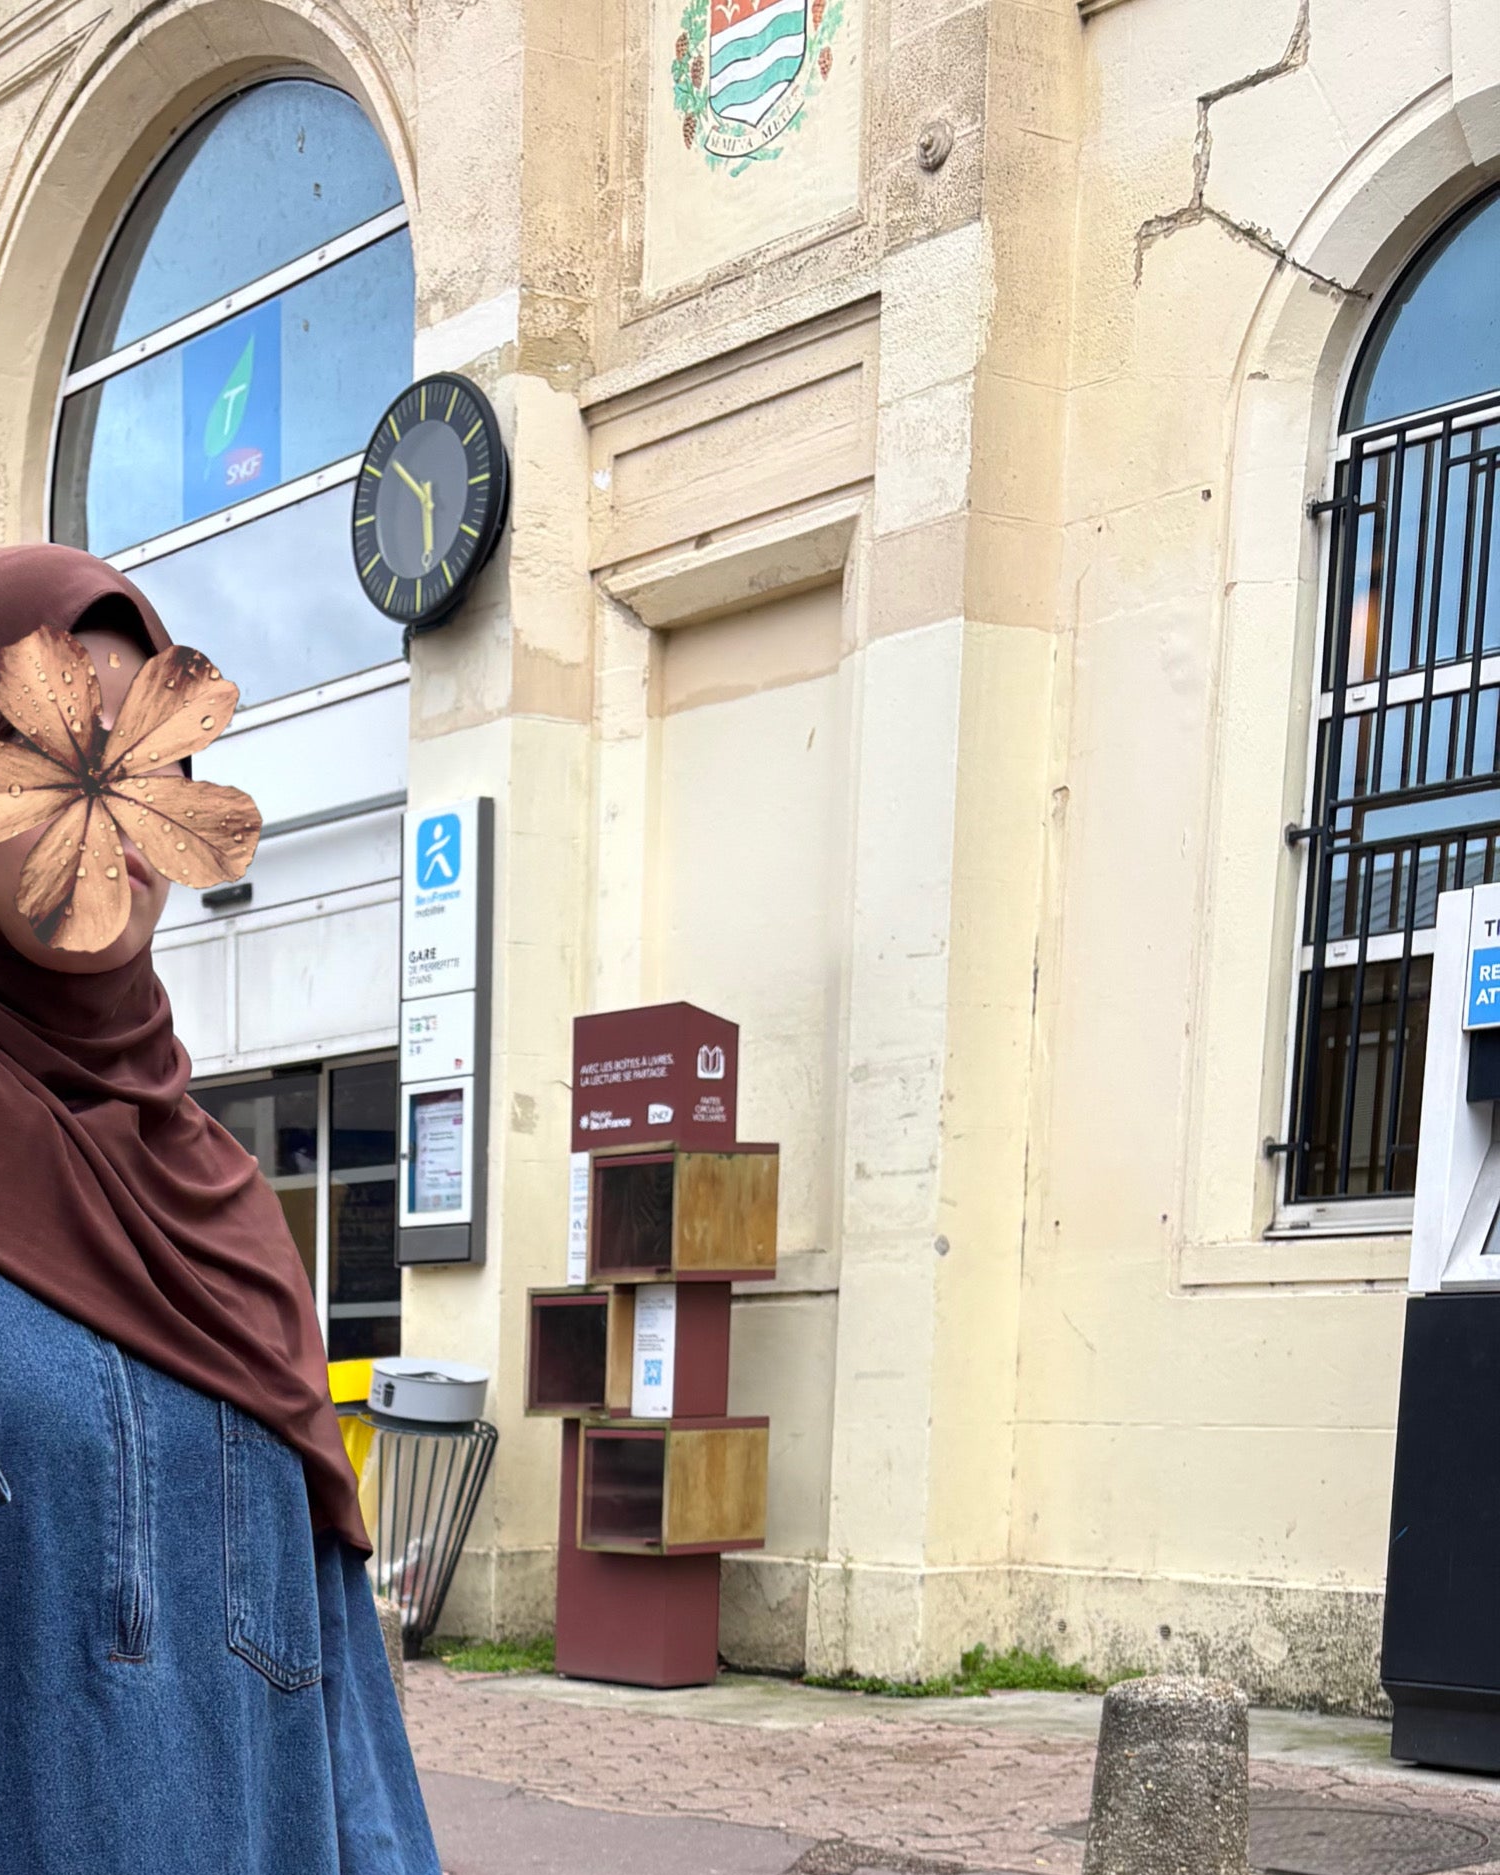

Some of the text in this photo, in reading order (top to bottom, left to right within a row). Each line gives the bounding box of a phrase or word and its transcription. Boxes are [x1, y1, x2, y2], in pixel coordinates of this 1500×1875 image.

[223, 383, 247, 436] T
[225, 452, 263, 487] SNCF
[408, 947, 436, 963] GARE
[580, 1062, 599, 1074] AVEC
[600, 1060, 613, 1072] LES
[580, 1076, 590, 1087] LA
[590, 1072, 622, 1085] LECTURE
[622, 1070, 632, 1081] SE
